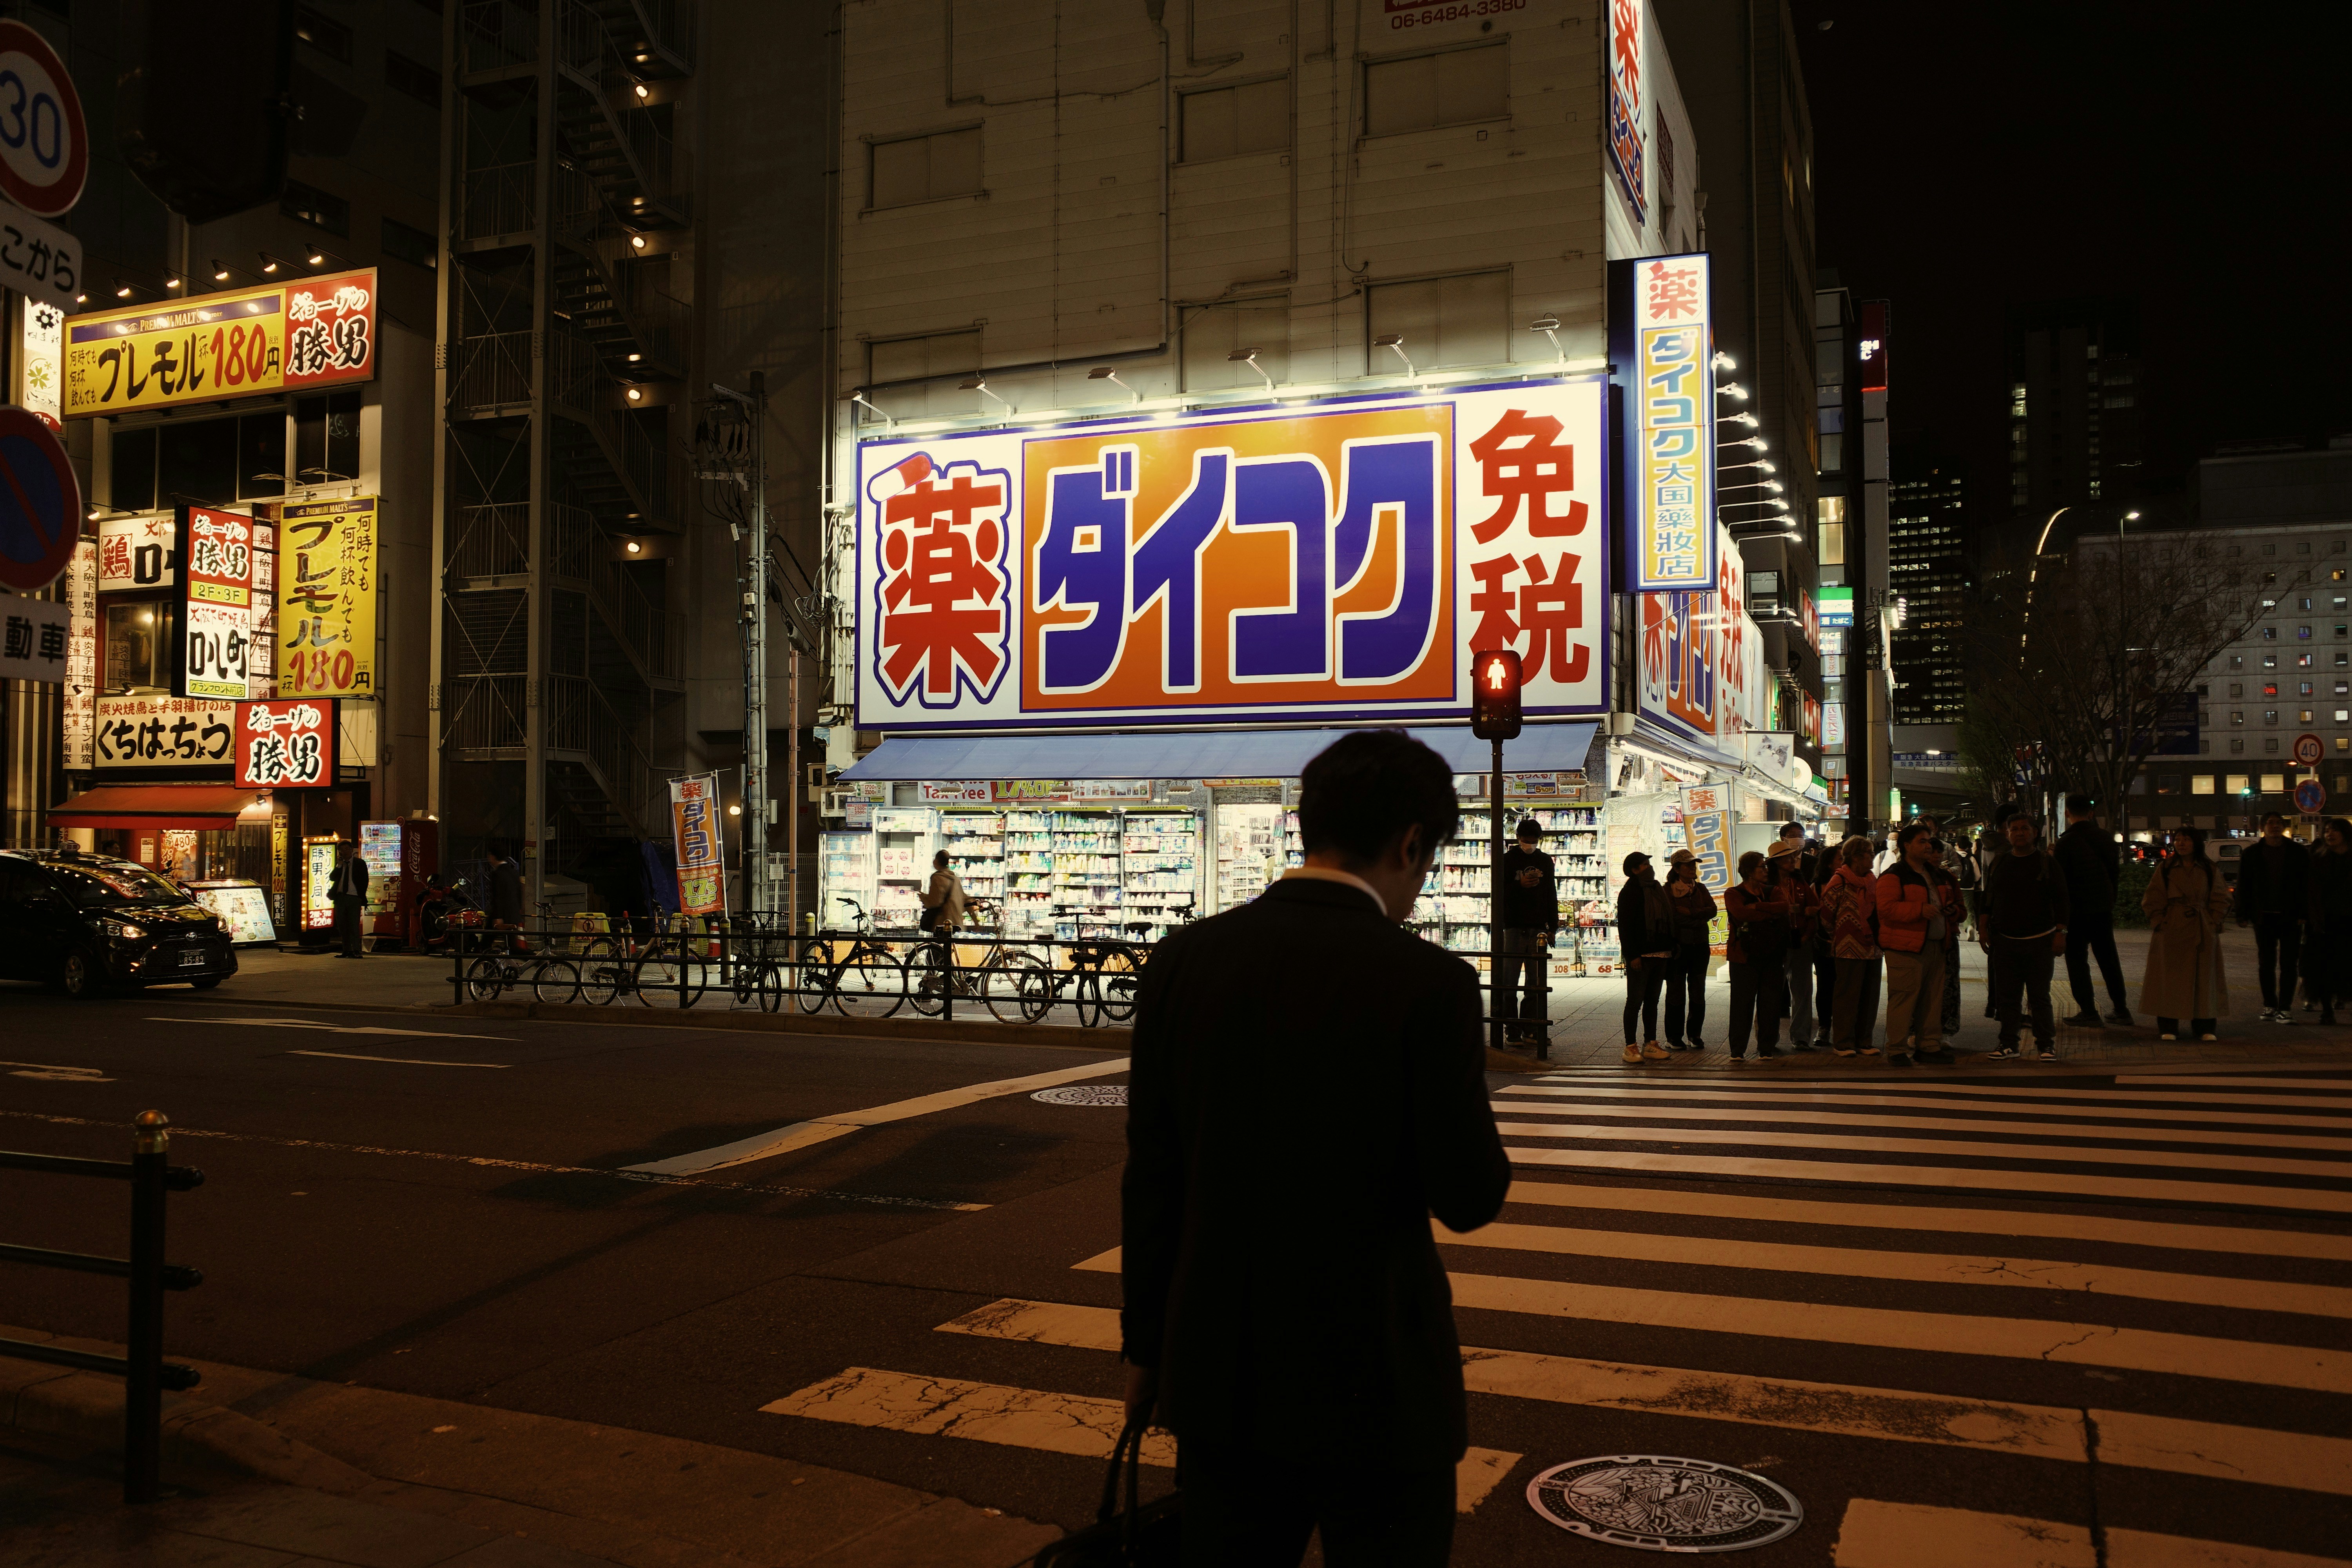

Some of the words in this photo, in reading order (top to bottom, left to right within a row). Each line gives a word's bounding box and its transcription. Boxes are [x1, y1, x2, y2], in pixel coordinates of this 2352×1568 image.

[1391, 0, 1526, 29] 06-6484-3380
[0, 70, 61, 169] 30
[1612, 86, 1642, 196] ダイコク
[1, 224, 75, 293] こから
[289, 285, 369, 322] ギョーザの
[1649, 267, 1699, 320] 薬
[173, 309, 201, 327] MALT'S
[69, 347, 96, 367] 何時でも
[98, 332, 205, 403] プレモル
[285, 314, 369, 376] 勝男
[69, 369, 85, 387] 何杯
[71, 387, 96, 407] 飲んでも
[1651, 330, 1697, 459] ダイコク
[193, 514, 248, 541] ギョーザの
[306, 505, 328, 515] PREMIUM
[330, 502, 348, 513] MALT'S
[83, 549, 95, 561] 鶏
[103, 535, 129, 577] 鶏
[190, 536, 249, 581] 勝男
[260, 533, 270, 546] 鶏
[356, 514, 373, 592] 何時でも
[1469, 409, 1589, 685] 免税
[259, 552, 270, 607] 大阪下町焼鳥
[285, 515, 346, 649] プレモル
[339, 525, 356, 644] 何杯飲んでも
[884, 468, 1002, 694] 薬
[1034, 435, 1439, 693] ダイコク
[83, 564, 95, 619] 大阪下町焼鳥
[4, 615, 66, 664] 動車
[82, 626, 94, 639] 鶏
[189, 606, 249, 630] 大阪下町焼鳥
[1719, 547, 1744, 695] 免税
[82, 641, 94, 691] 炎の手羽揚げ
[82, 697, 93, 710] 鶏
[99, 699, 231, 716] 炭火焼鳥と手羽揚げの店
[191, 683, 243, 696] グランフロント前店
[80, 713, 94, 764] チキン南蛮
[98, 713, 231, 760] くちはっちょう
[248, 704, 321, 731] ギョーザの
[245, 731, 322, 784] 勝男
[2301, 743, 2318, 757] 40
[681, 782, 702, 799] 薬
[1689, 789, 1718, 811] 薬
[274, 830, 283, 877] プレモル
[409, 829, 420, 874] Coca-Cola
[683, 801, 709, 861] ダイコク
[1693, 814, 1728, 887] ダイコク
[687, 893, 715, 906] OFF
[184, 956, 203, 964] 85-89
